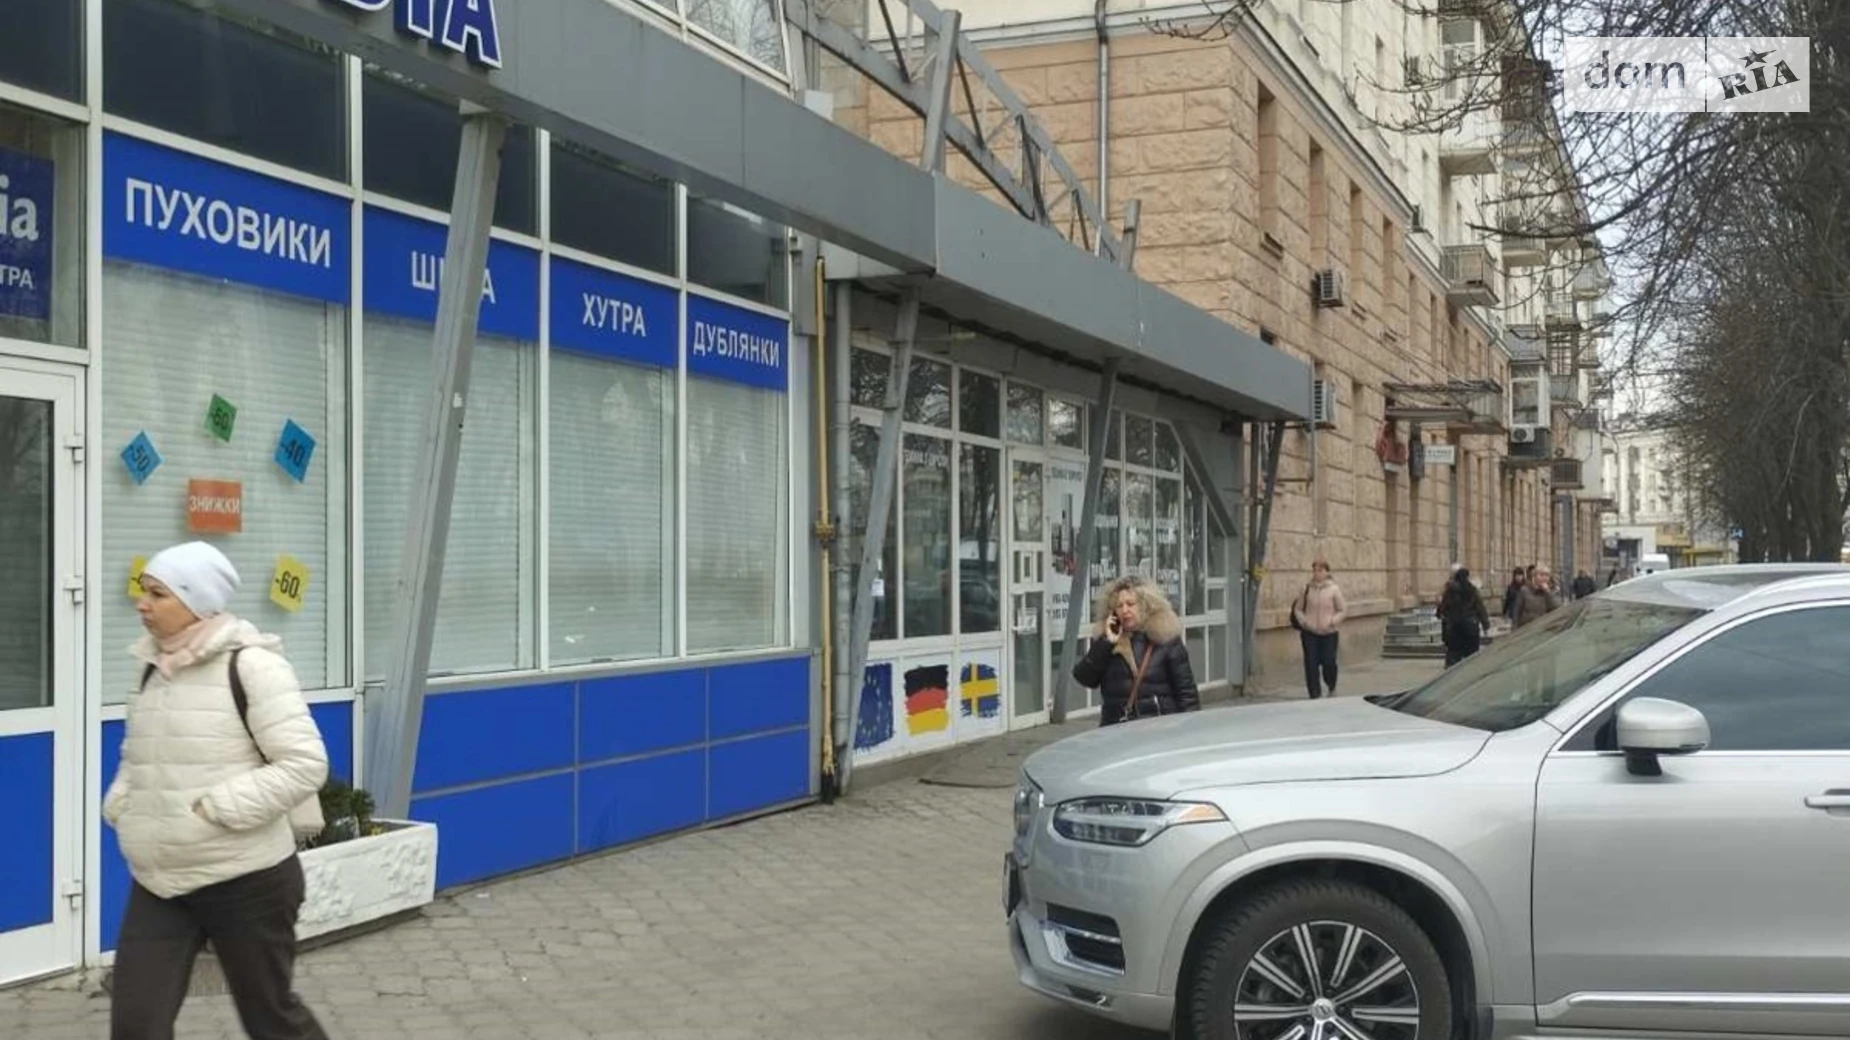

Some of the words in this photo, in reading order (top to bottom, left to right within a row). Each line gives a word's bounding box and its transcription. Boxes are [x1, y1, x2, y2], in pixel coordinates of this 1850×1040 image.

[125, 177, 331, 268] ПУХОВИКИ
[582, 293, 647, 337] ХУТРА
[693, 320, 780, 368] ДУБЛЯНКИ
[189, 495, 240, 513] ЗНИЖКИ
